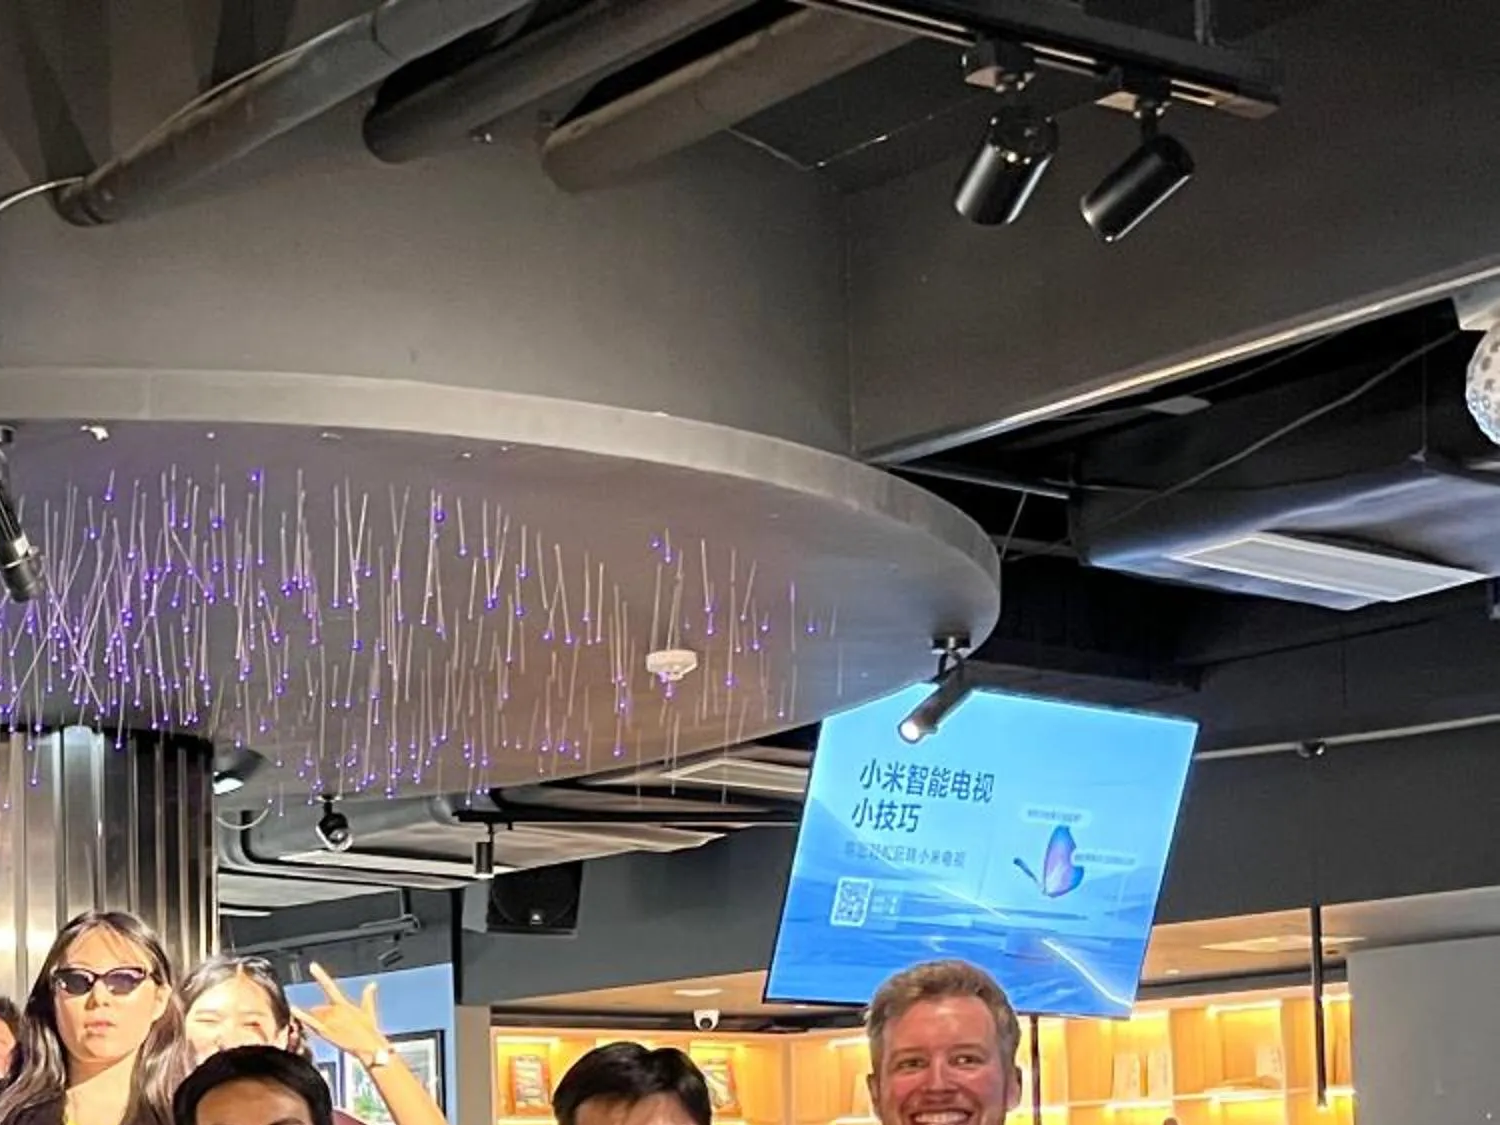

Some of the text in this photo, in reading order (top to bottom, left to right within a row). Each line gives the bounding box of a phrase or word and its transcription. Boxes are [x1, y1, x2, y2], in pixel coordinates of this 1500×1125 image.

[859, 757, 995, 803] 小米智能电视
[851, 797, 922, 833] 小技巧
